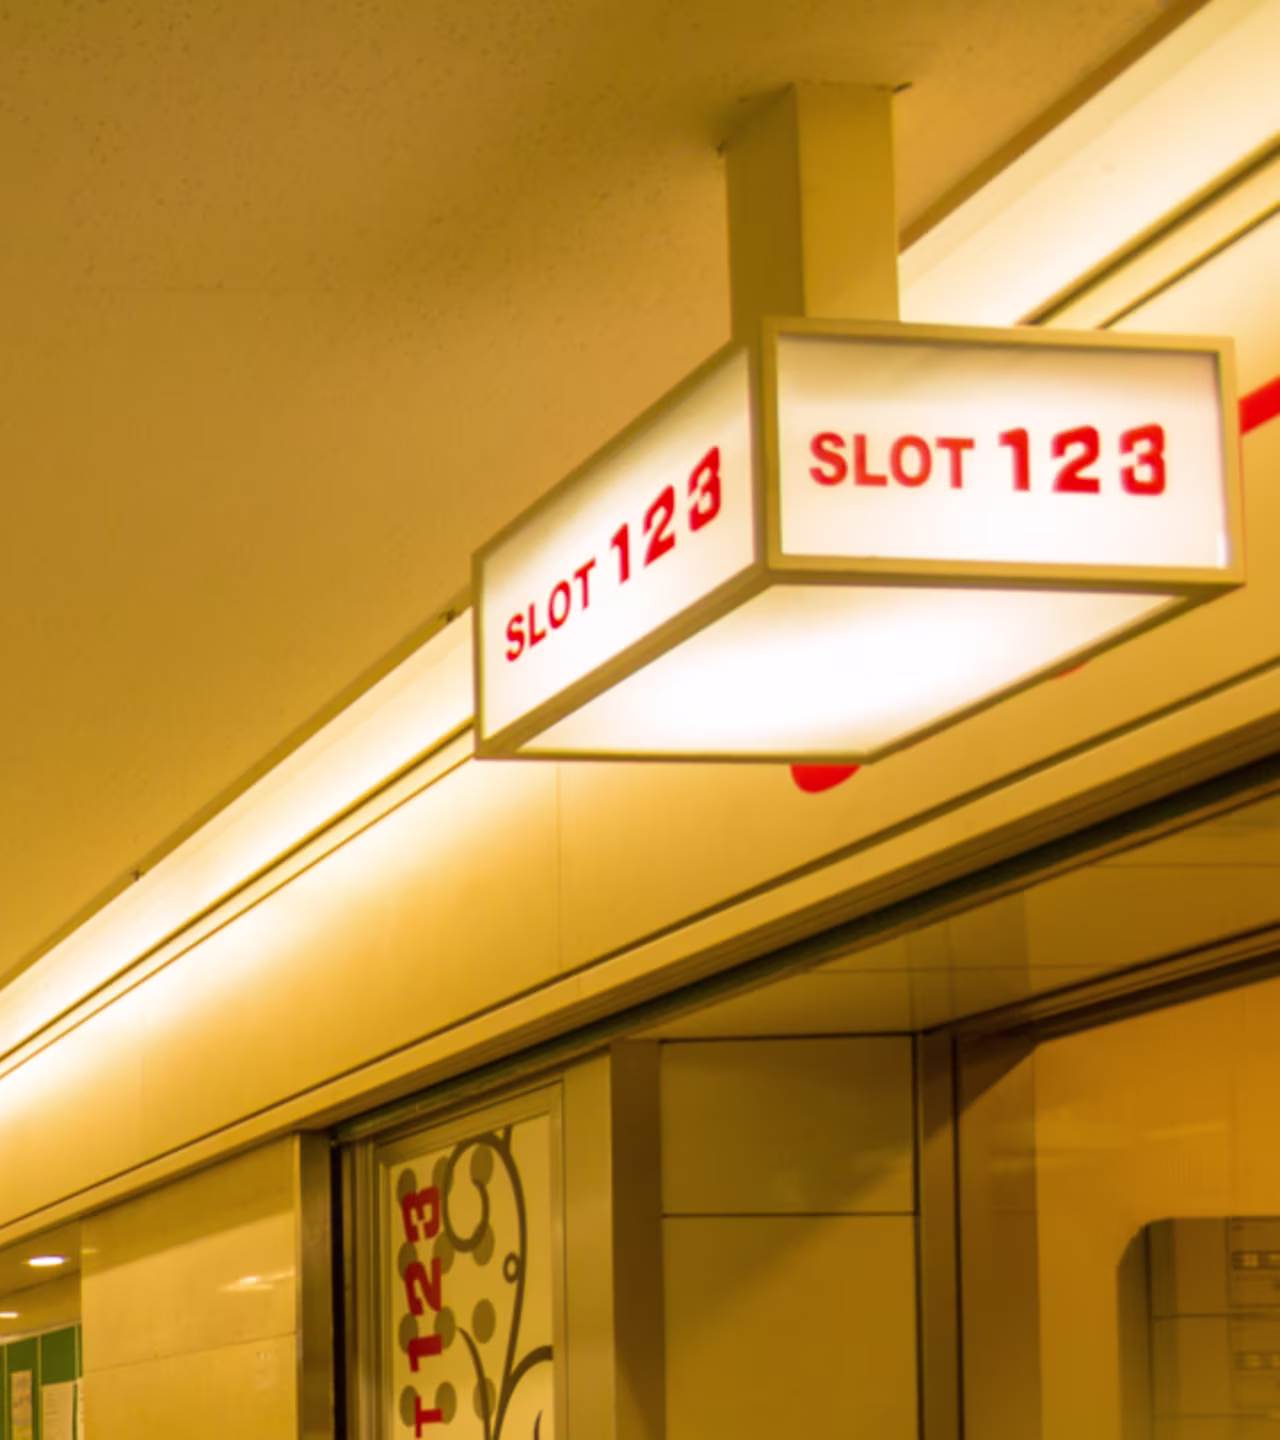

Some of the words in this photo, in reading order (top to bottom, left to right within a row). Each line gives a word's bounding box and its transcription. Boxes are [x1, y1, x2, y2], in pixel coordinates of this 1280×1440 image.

[809, 431, 975, 489] SLOT
[998, 423, 1167, 496] 123
[504, 557, 597, 663] SLOT
[609, 445, 723, 586] 123
[401, 1185, 444, 1373] 123
